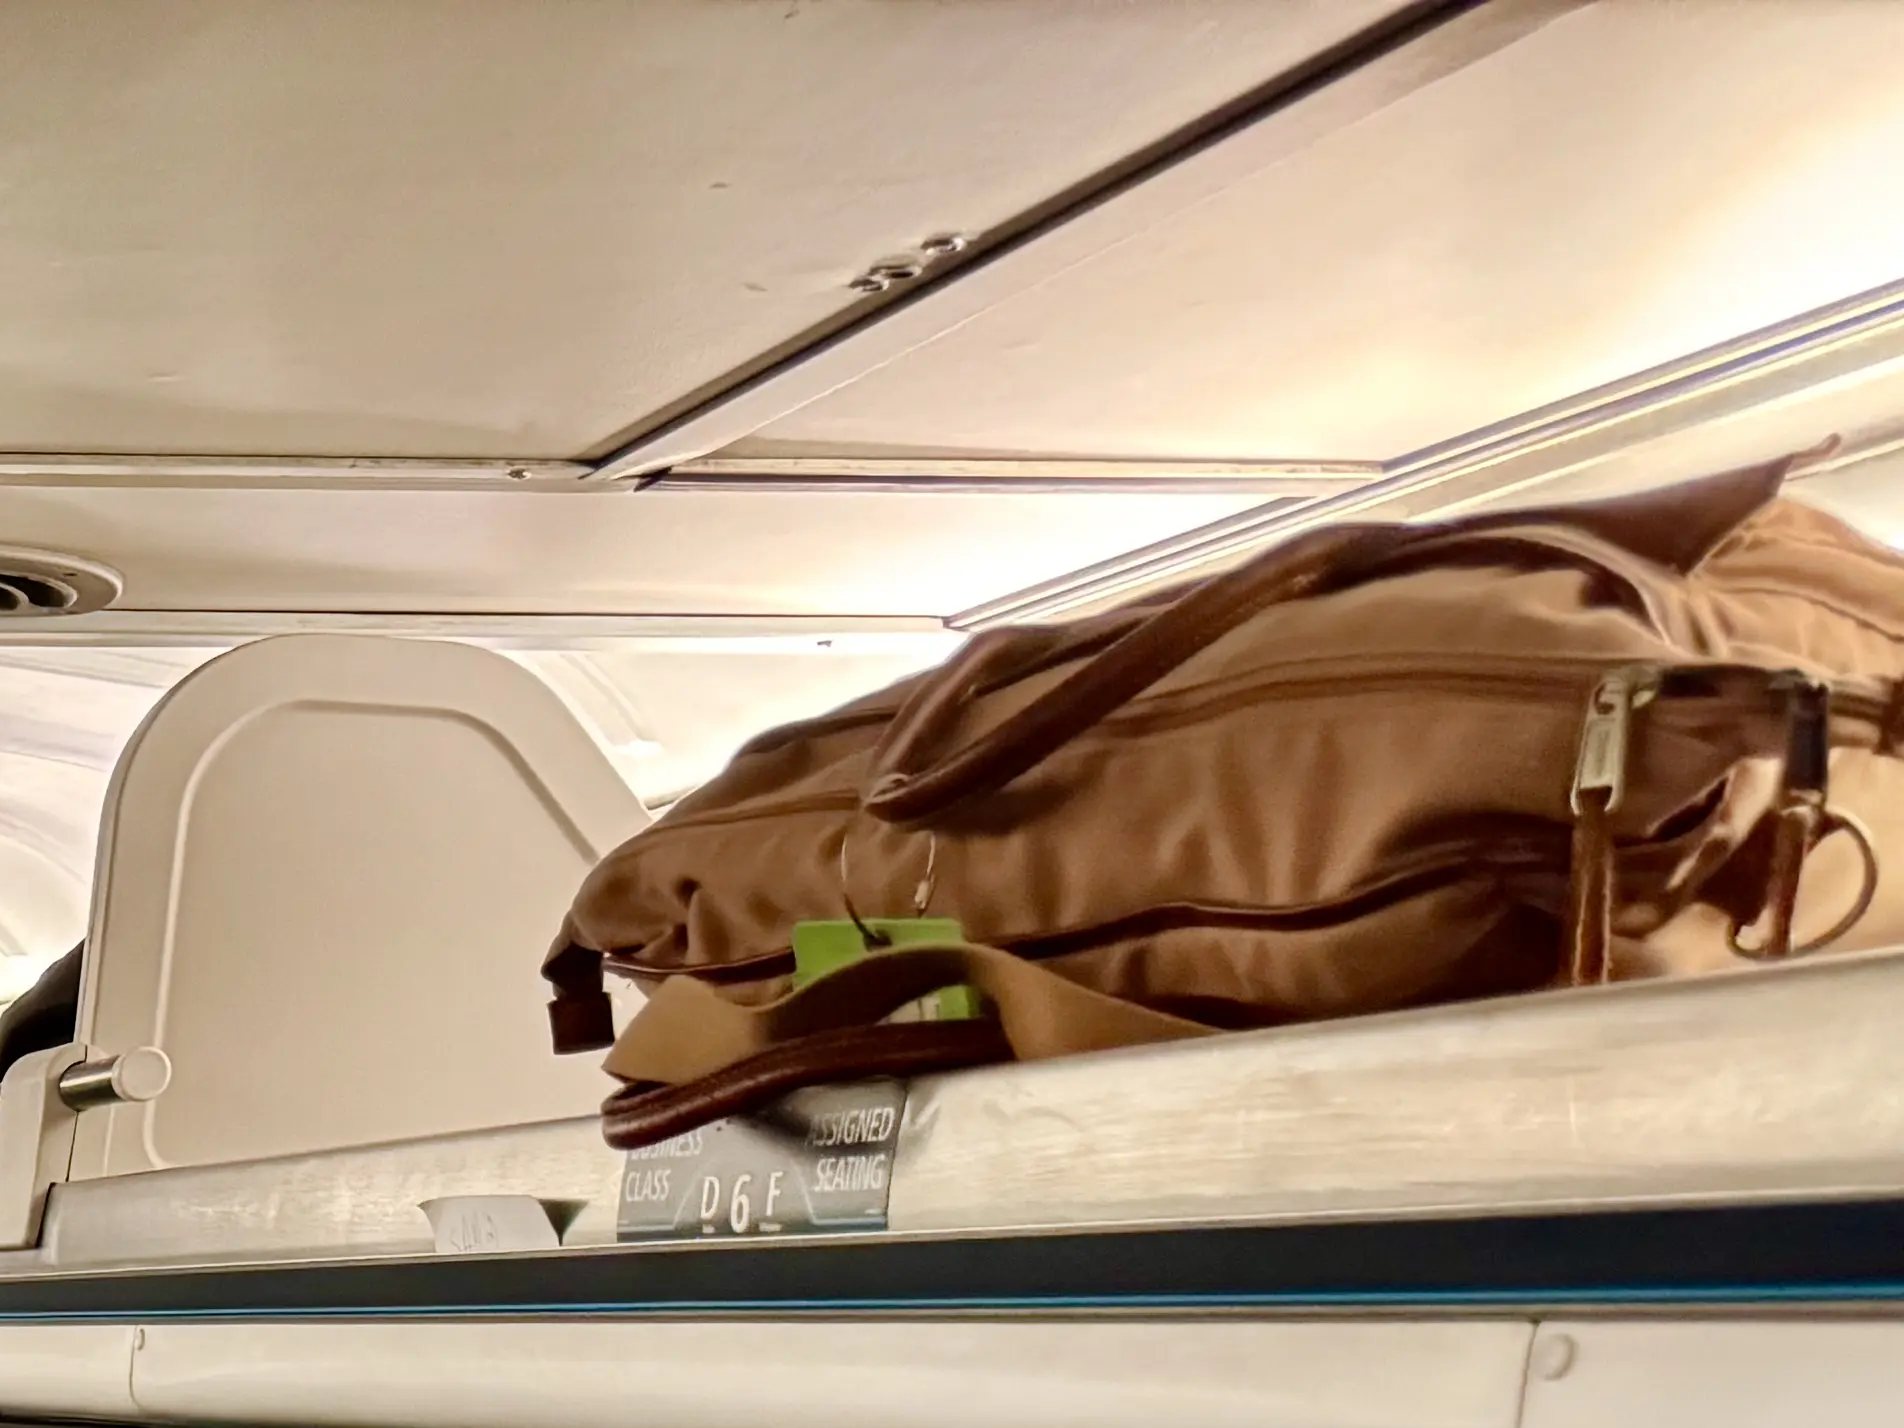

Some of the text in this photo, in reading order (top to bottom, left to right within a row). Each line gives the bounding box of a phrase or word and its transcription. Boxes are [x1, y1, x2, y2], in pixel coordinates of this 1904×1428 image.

[805, 1107, 896, 1147] ASSIGNED
[625, 1168, 672, 1202] CLASS
[813, 1153, 886, 1193] SEATING
